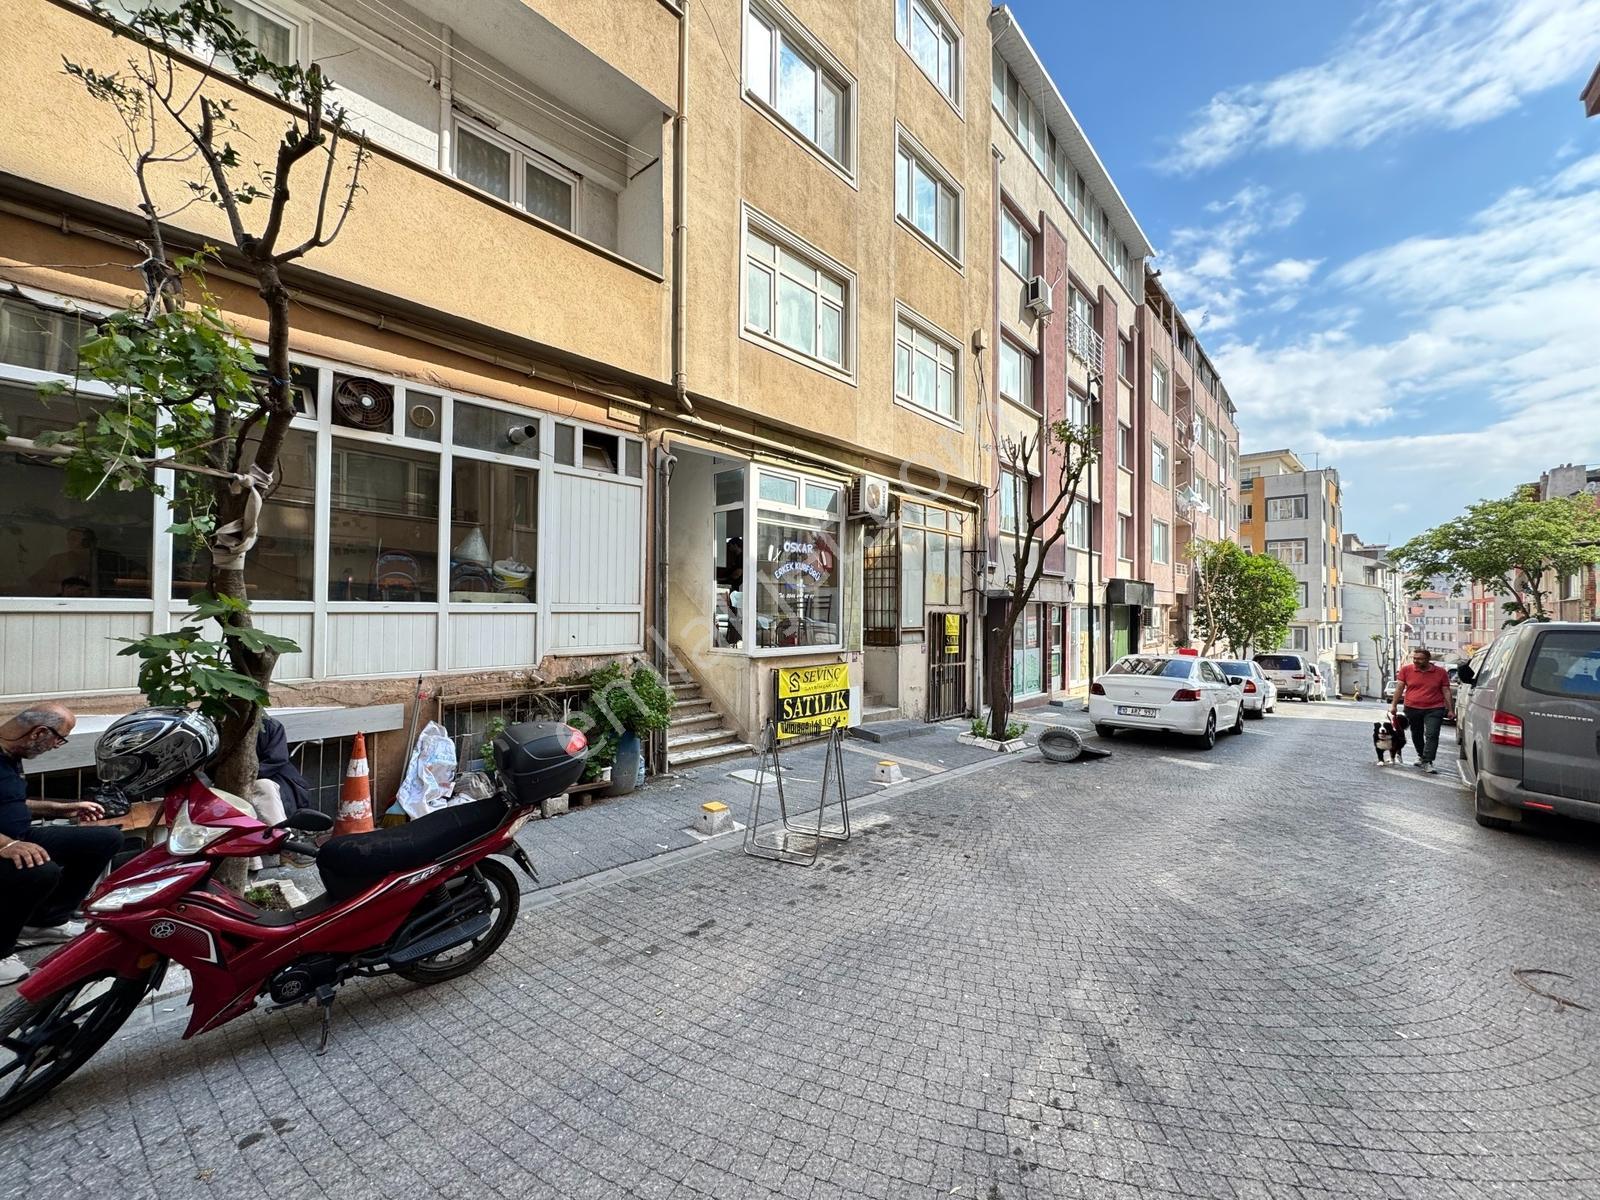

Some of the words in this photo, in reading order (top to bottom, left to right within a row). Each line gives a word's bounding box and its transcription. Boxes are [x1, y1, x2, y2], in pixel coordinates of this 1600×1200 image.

[774, 562, 795, 579] ERKEK
[803, 667, 841, 683] SEVİNÇ
[783, 690, 848, 720] SATILIK
[1529, 711, 1594, 722] TRANSPORTER
